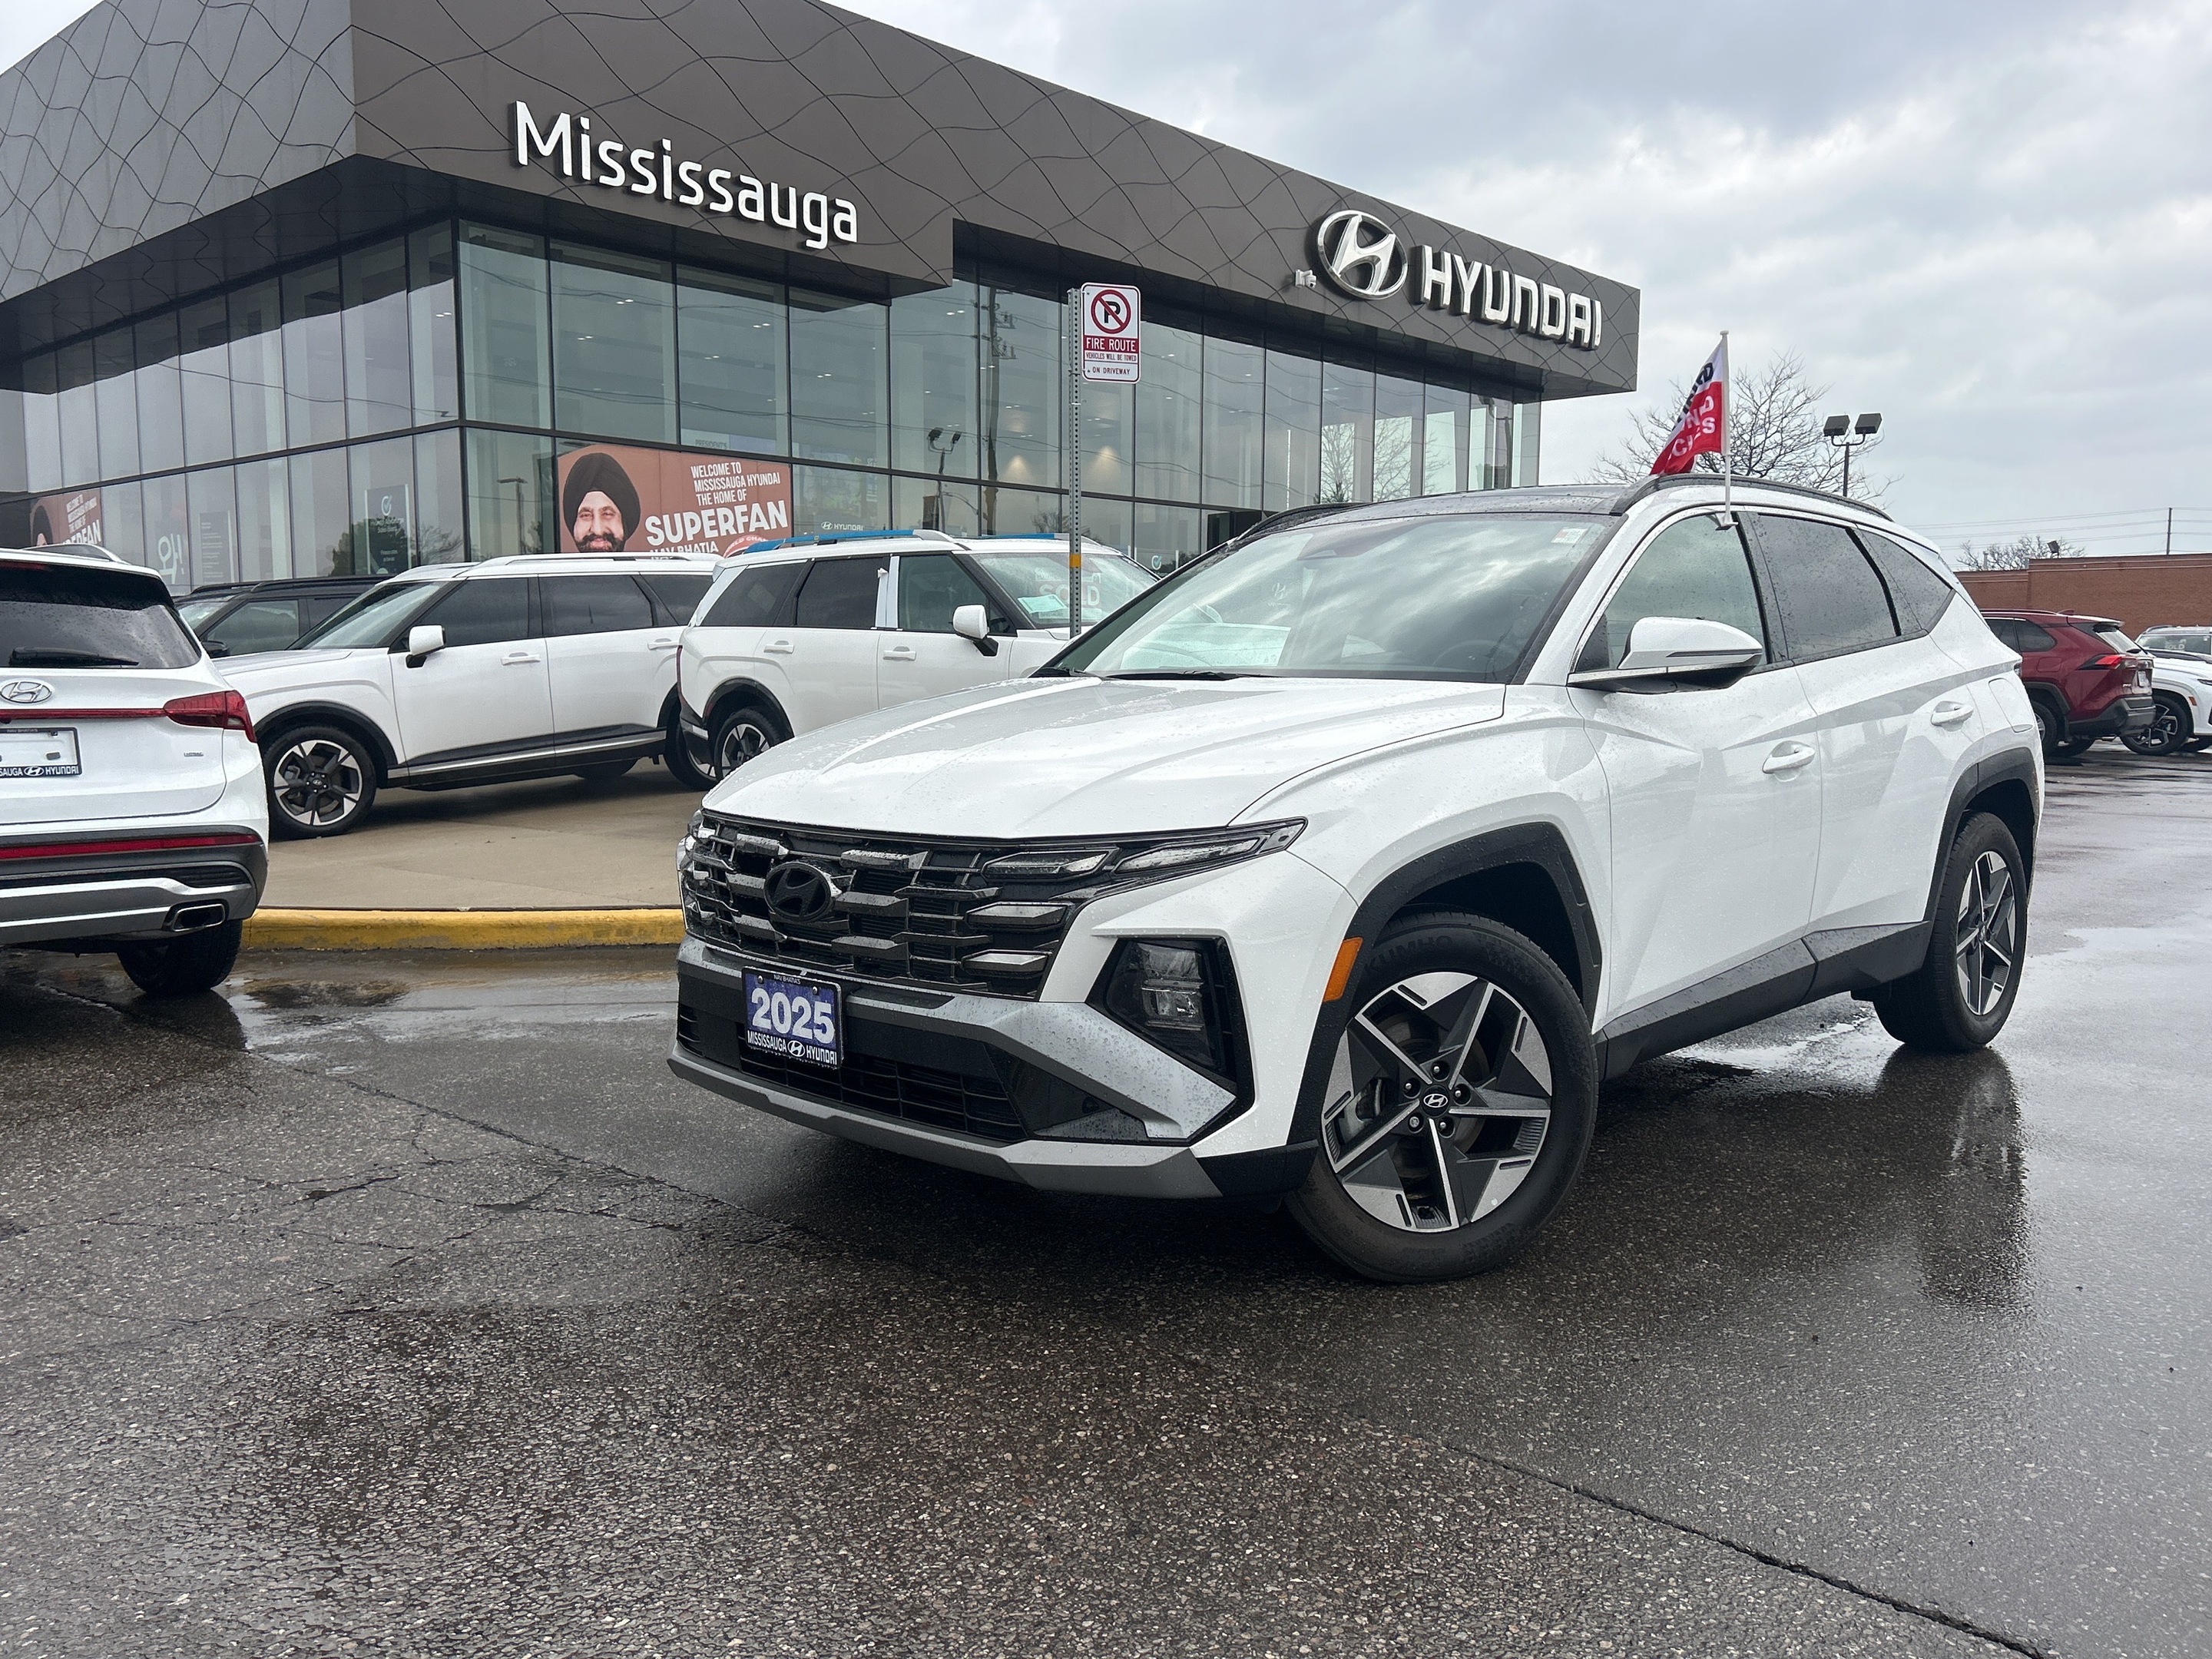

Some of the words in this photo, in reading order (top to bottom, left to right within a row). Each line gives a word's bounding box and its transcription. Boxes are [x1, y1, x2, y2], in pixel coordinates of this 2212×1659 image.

[514, 100, 858, 250] Mississauga
[1418, 244, 1602, 350] HYUNDAI
[1086, 337, 1105, 349] FIRE
[1108, 339, 1136, 352] ROUTE
[1086, 352, 1104, 360] VEHICLES
[690, 462, 730, 478] WELCOME
[730, 462, 742, 475] TO
[694, 475, 747, 492] MISSISSAUGA
[747, 472, 780, 487] HYUNDAI
[696, 492, 713, 506] THE
[714, 490, 737, 505] HOME
[737, 488, 747, 502] OF
[644, 500, 789, 546] SUPERFAN
[834, 523, 863, 531] HYUNDAI
[677, 540, 720, 553] BHATIA
[1039, 584, 1101, 606] SOD
[46, 766, 79, 775] HYUNDAI
[751, 987, 836, 1045] 2025
[747, 1030, 787, 1053] MISSISSAUGA
[806, 1045, 837, 1065] HYUNDAI
